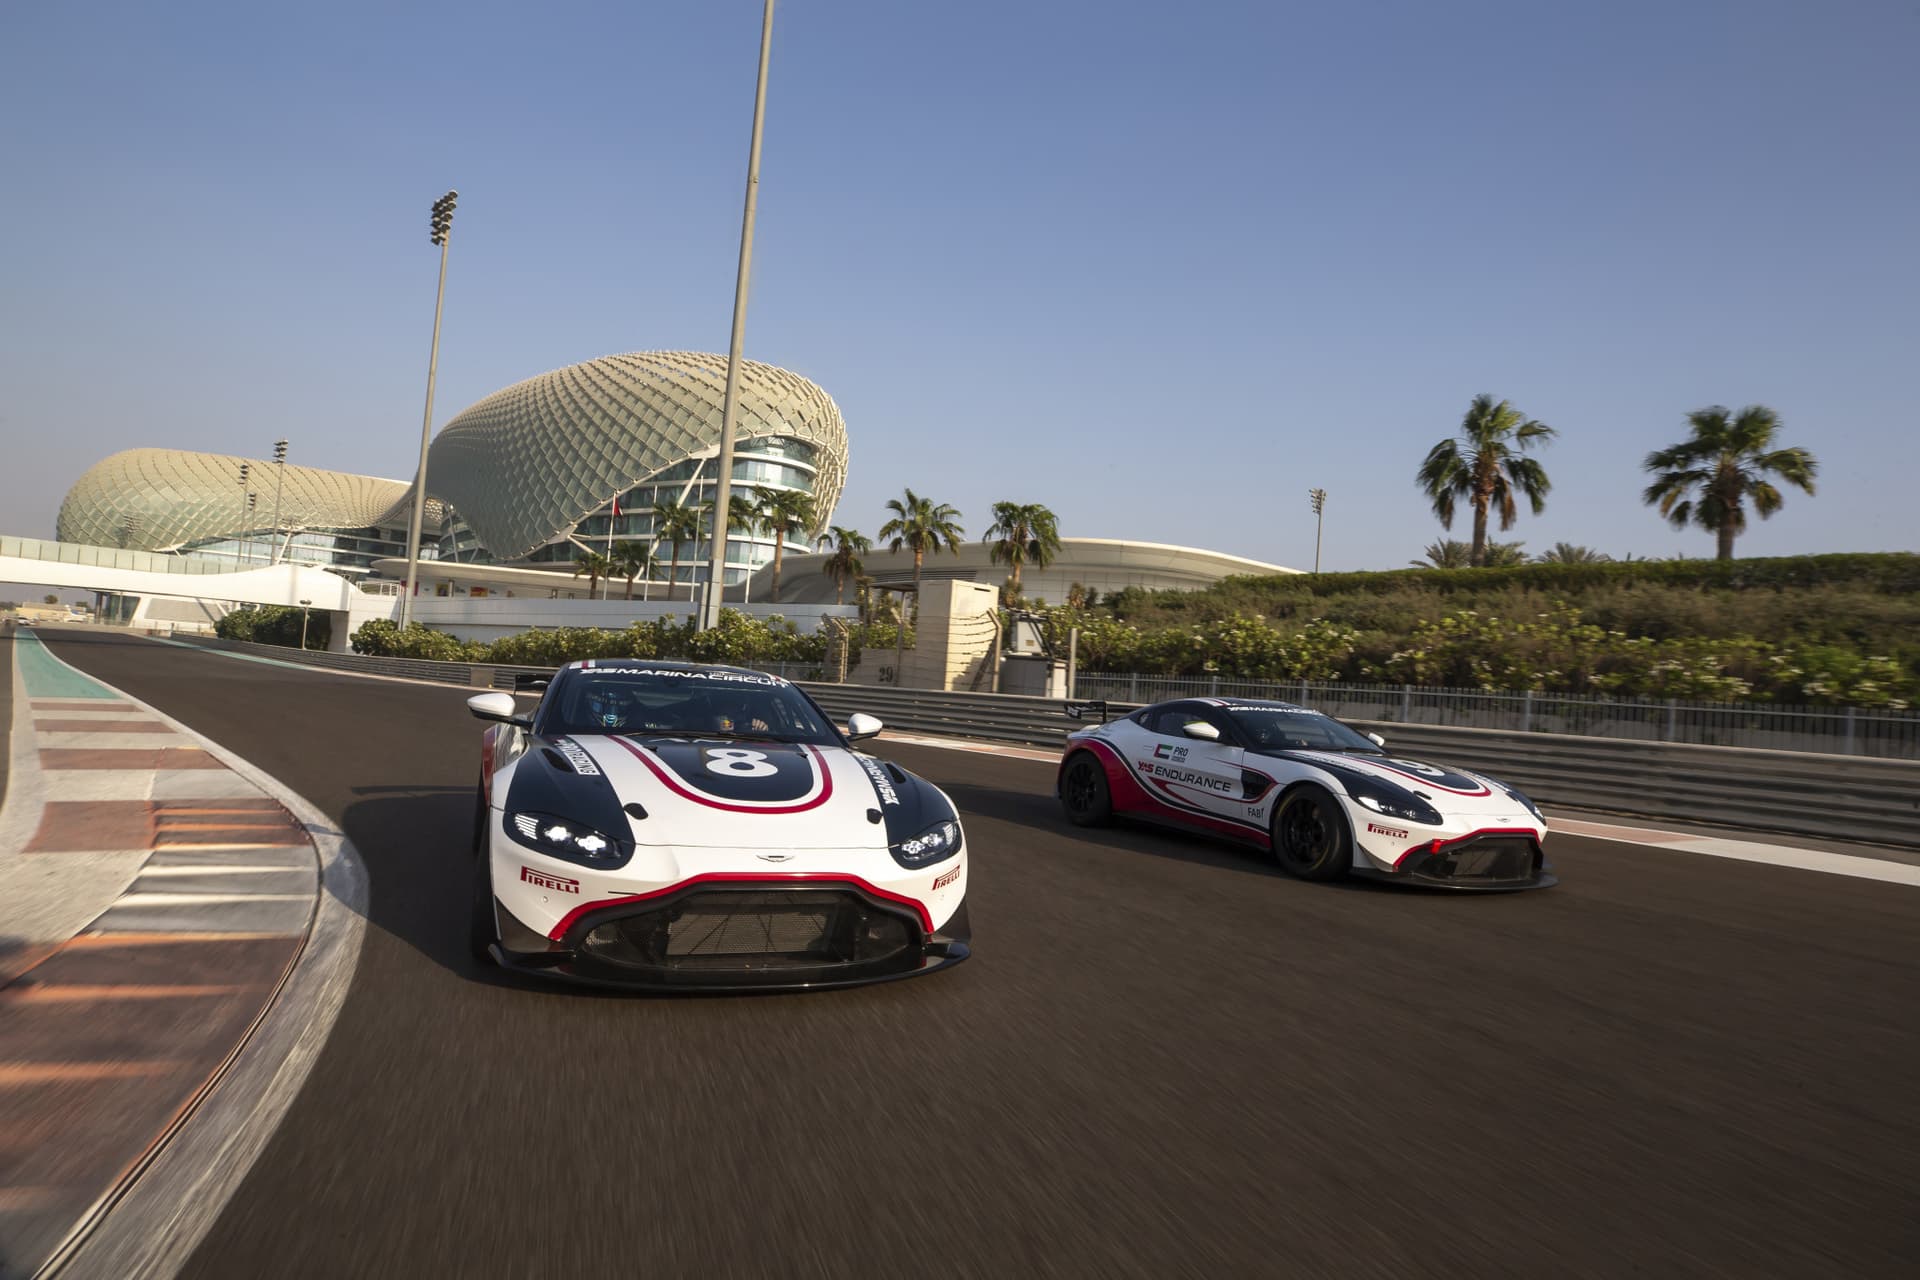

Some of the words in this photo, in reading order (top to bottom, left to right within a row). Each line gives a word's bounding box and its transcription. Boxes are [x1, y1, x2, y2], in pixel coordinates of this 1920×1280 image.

[706, 748, 778, 777] 8
[1173, 746, 1189, 757] PRO
[1138, 761, 1154, 773] YAS
[1154, 766, 1232, 793] ENDURANCE
[1367, 823, 1409, 838] PIRELLI
[521, 865, 580, 894] PIRELLI
[932, 865, 960, 890] PIRELLI
